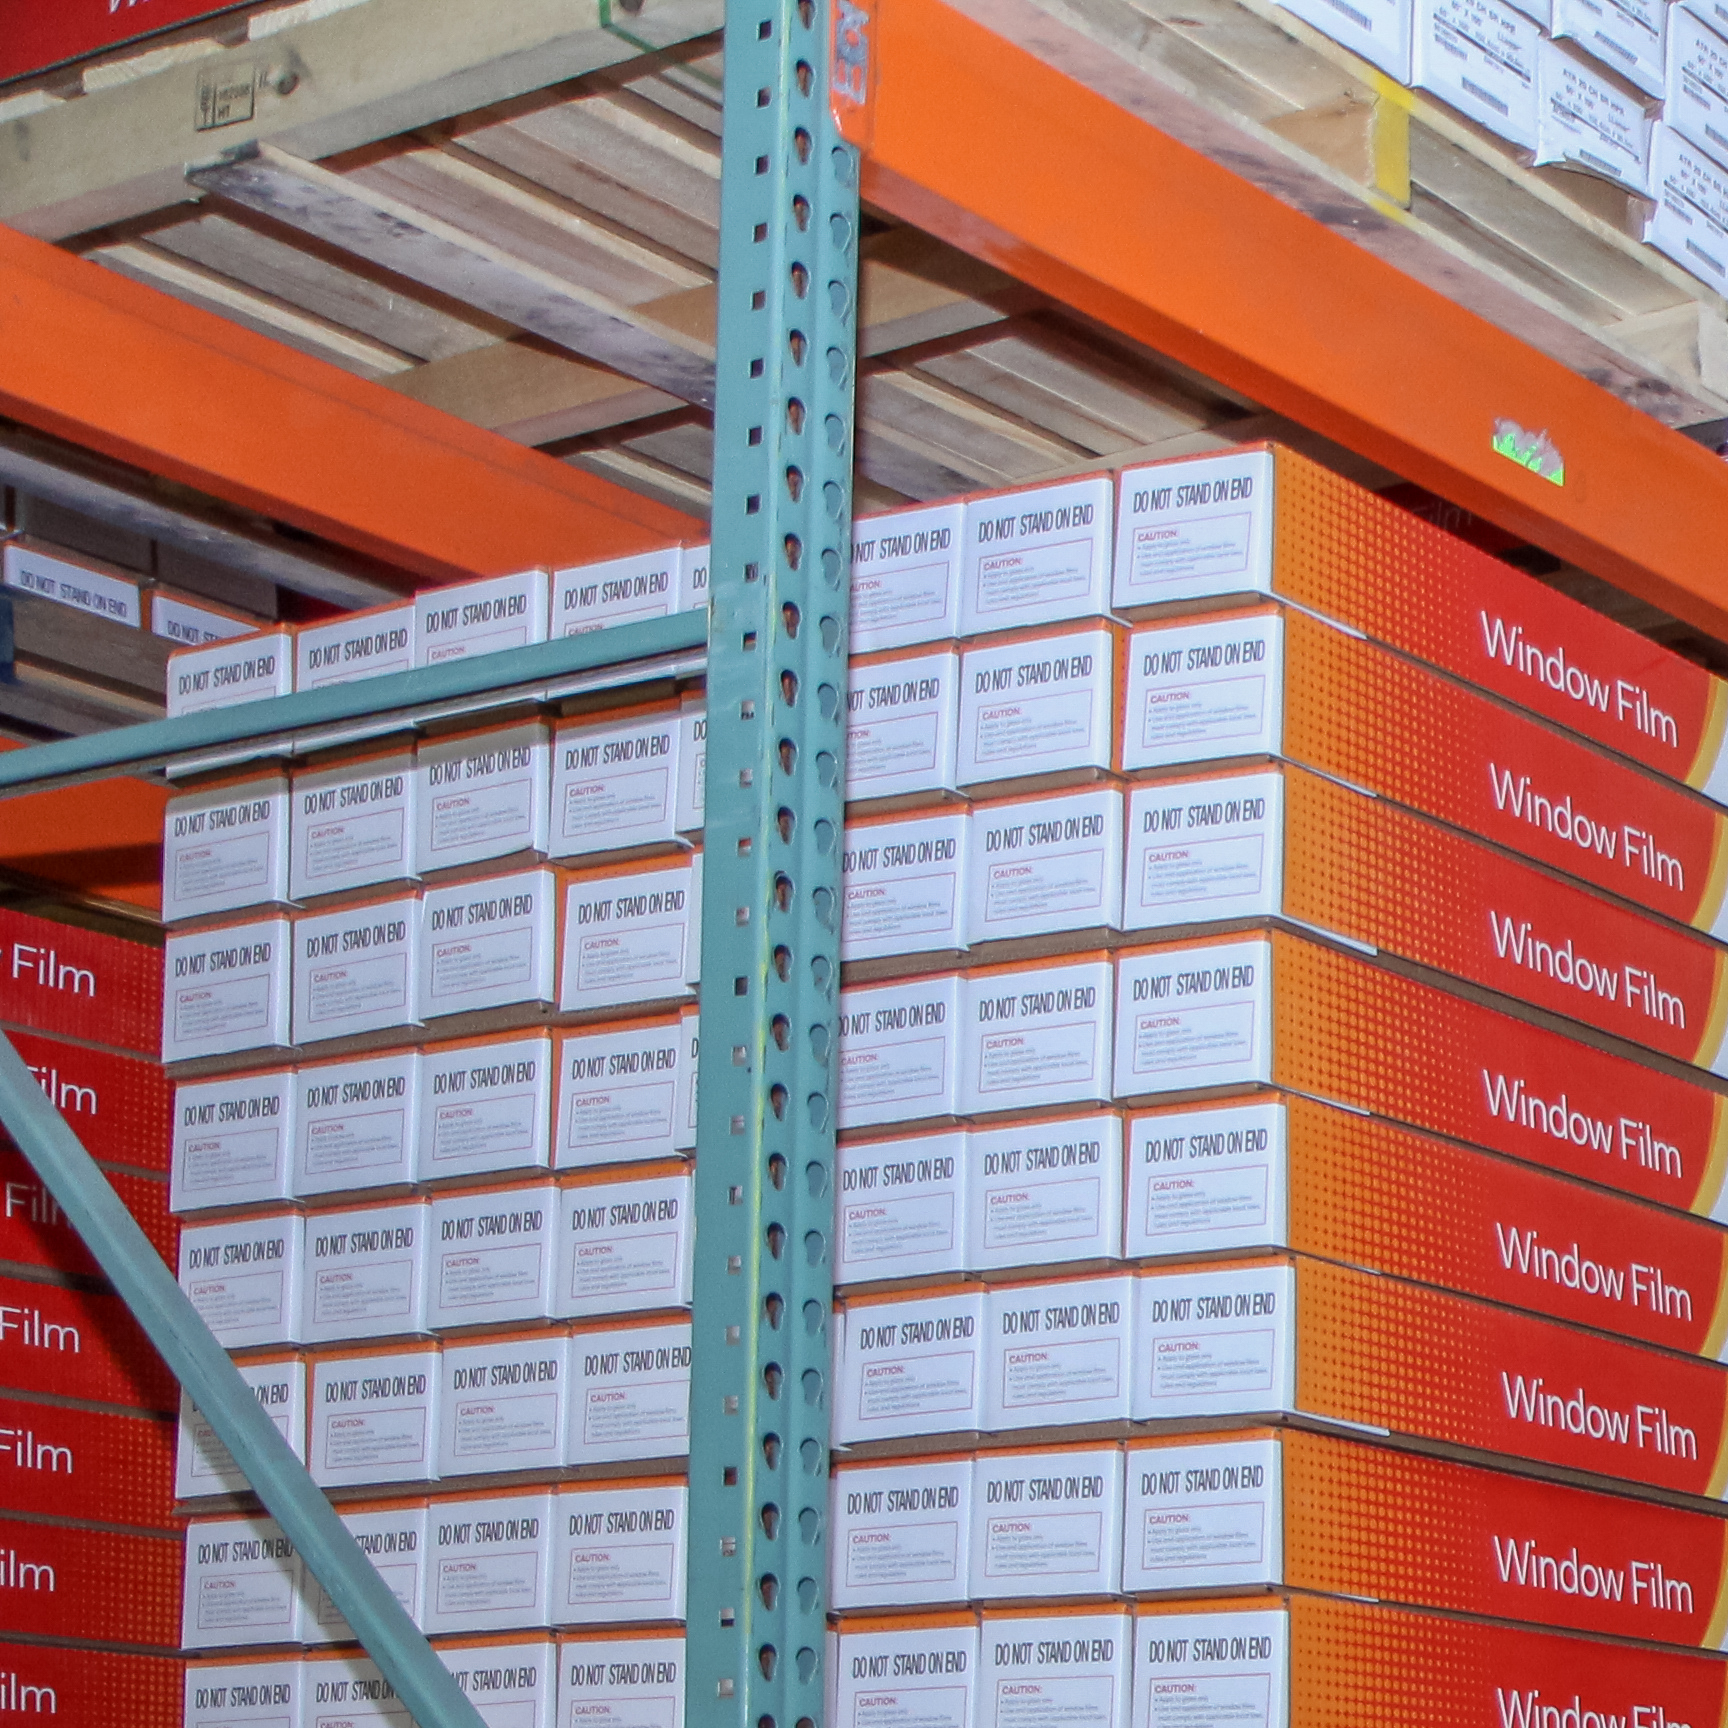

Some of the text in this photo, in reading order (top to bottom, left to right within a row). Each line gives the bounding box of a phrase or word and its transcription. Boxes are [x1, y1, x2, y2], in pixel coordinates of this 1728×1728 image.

[1481, 611, 1676, 747] Window Film
[1490, 763, 1683, 891] Window Film
[1491, 911, 1684, 1028] Window Film
[1483, 1069, 1681, 1178] Window Film
[1497, 1223, 1691, 1321] Window Film
[1502, 1372, 1696, 1460] Window Film
[1494, 1536, 1692, 1613] Window Film
